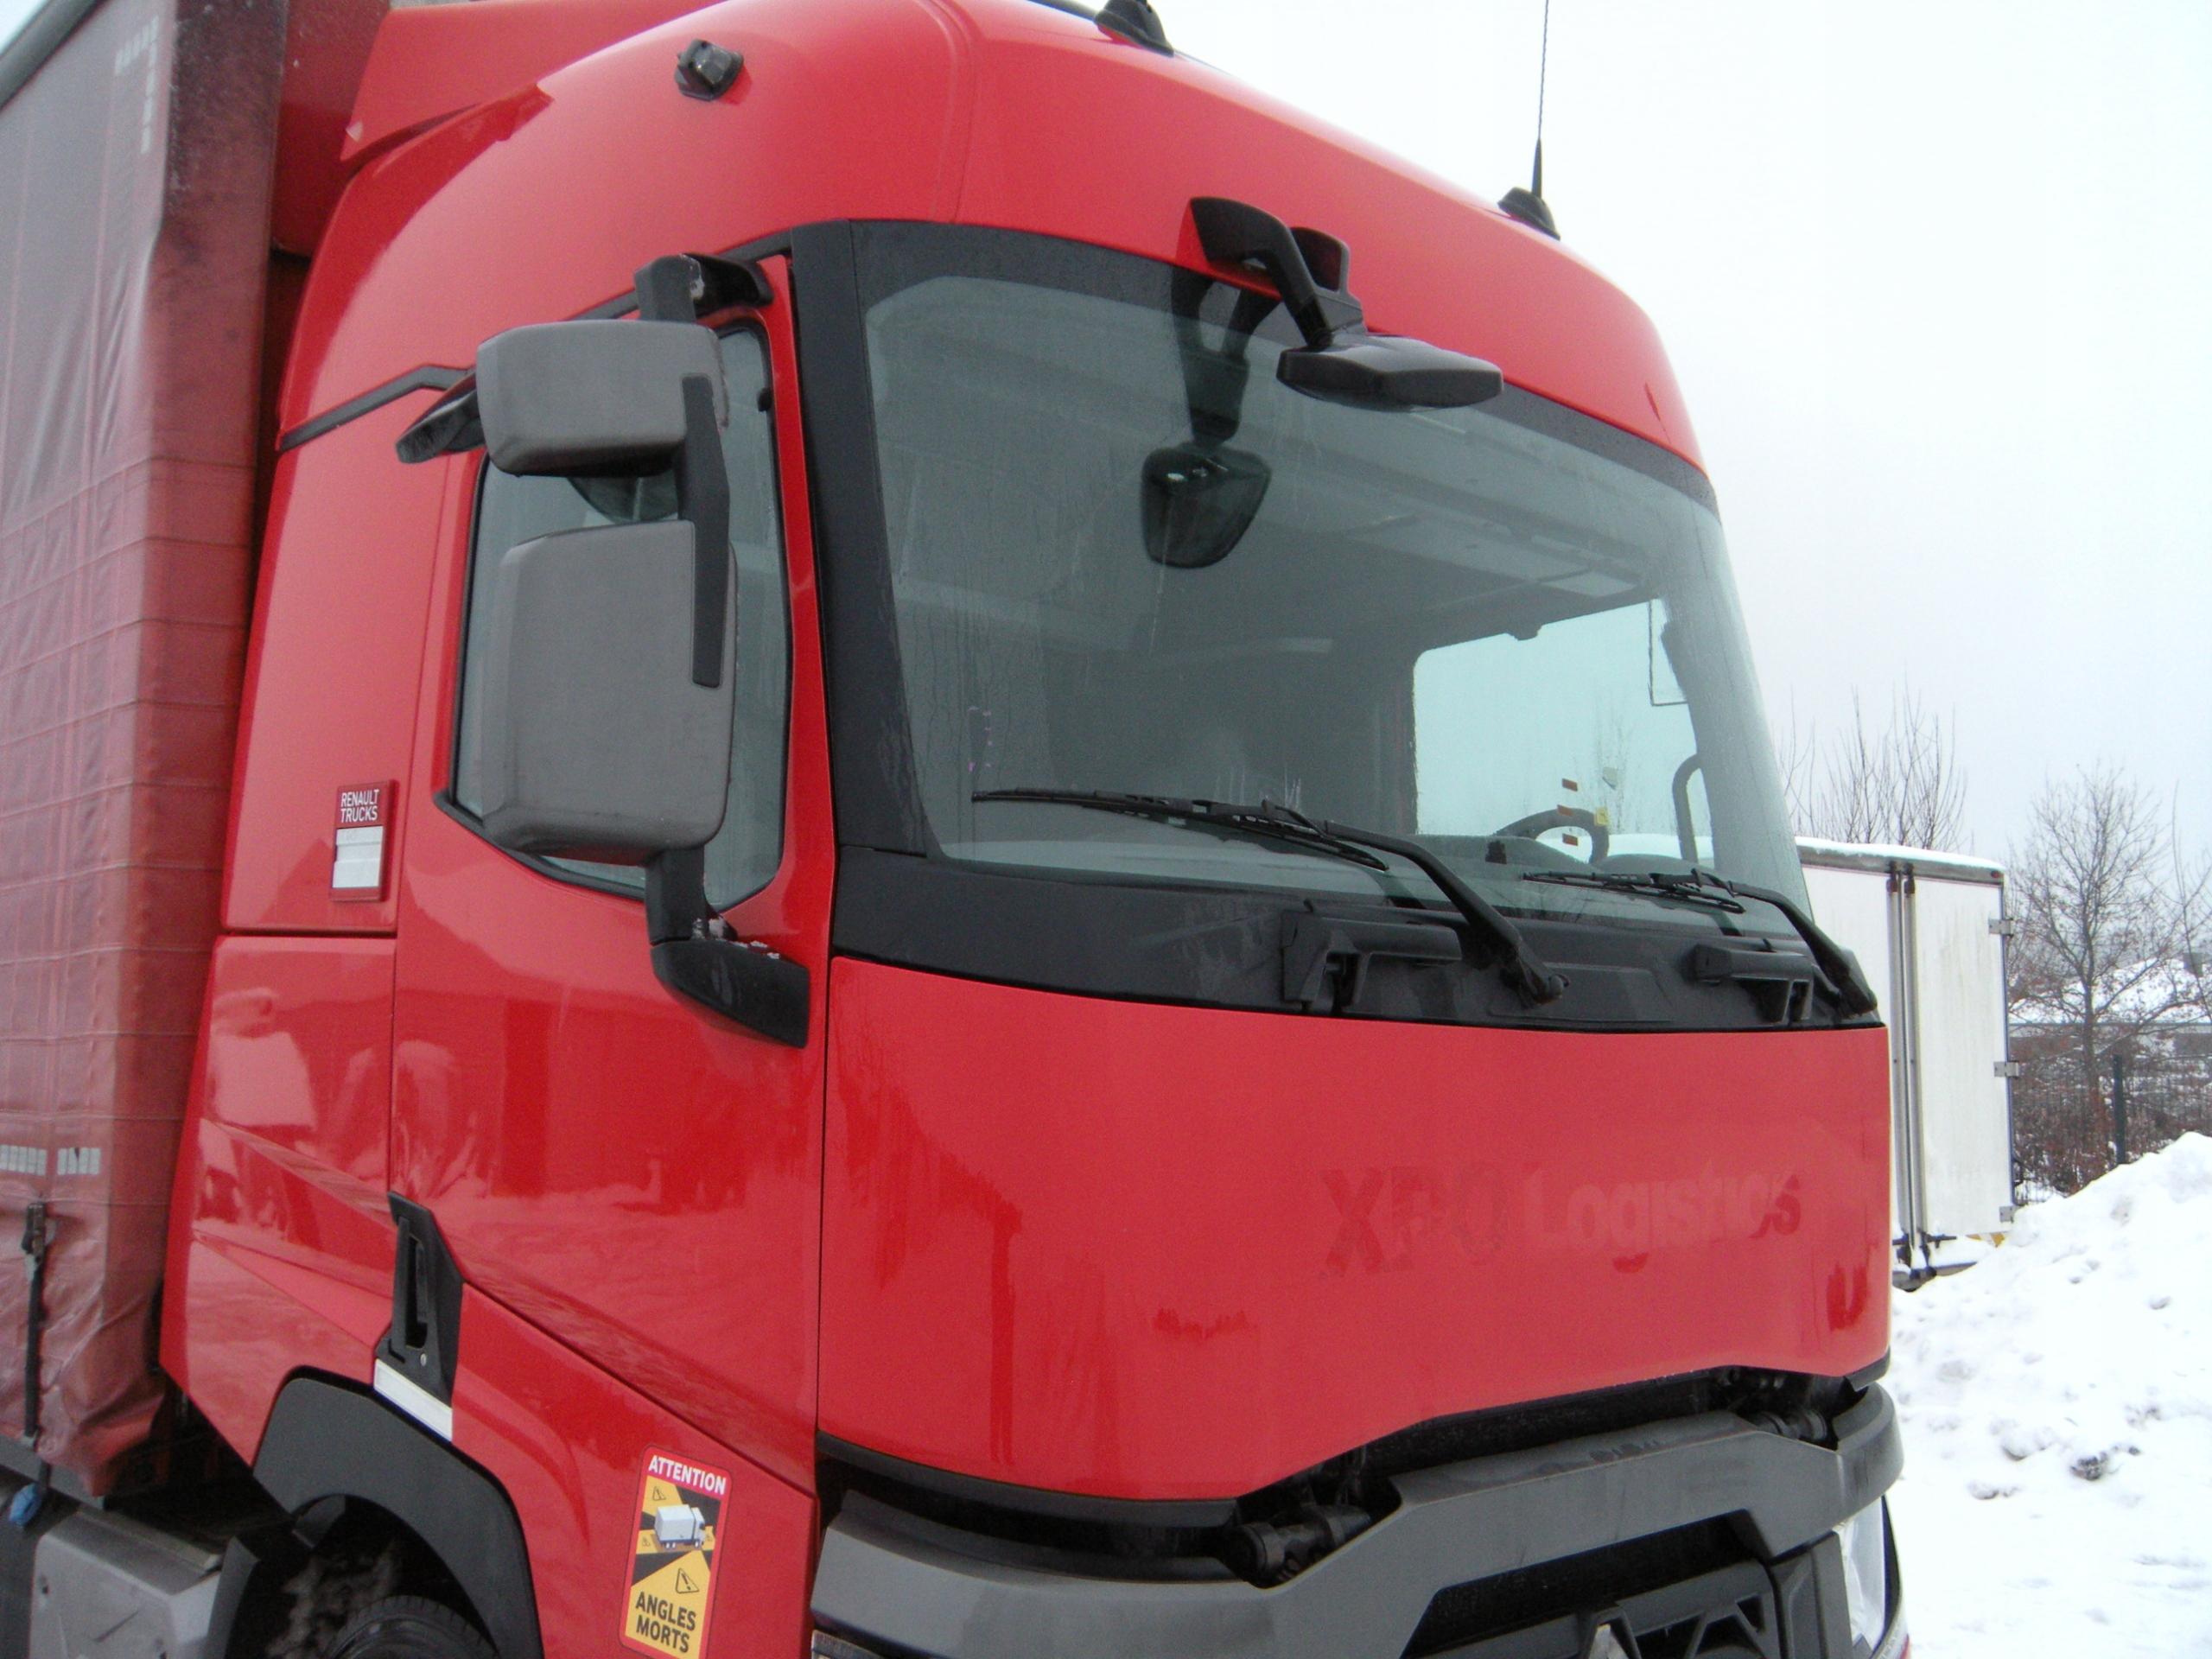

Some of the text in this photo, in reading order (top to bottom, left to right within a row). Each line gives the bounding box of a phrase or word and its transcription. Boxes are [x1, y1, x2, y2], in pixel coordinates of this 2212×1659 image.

[340, 806, 378, 823] TRUCKS
[341, 790, 379, 806] RENAULT
[649, 1455, 726, 1495] ATTENTION
[635, 1591, 696, 1631] ANGLES
[636, 1614, 690, 1654] MORTS
